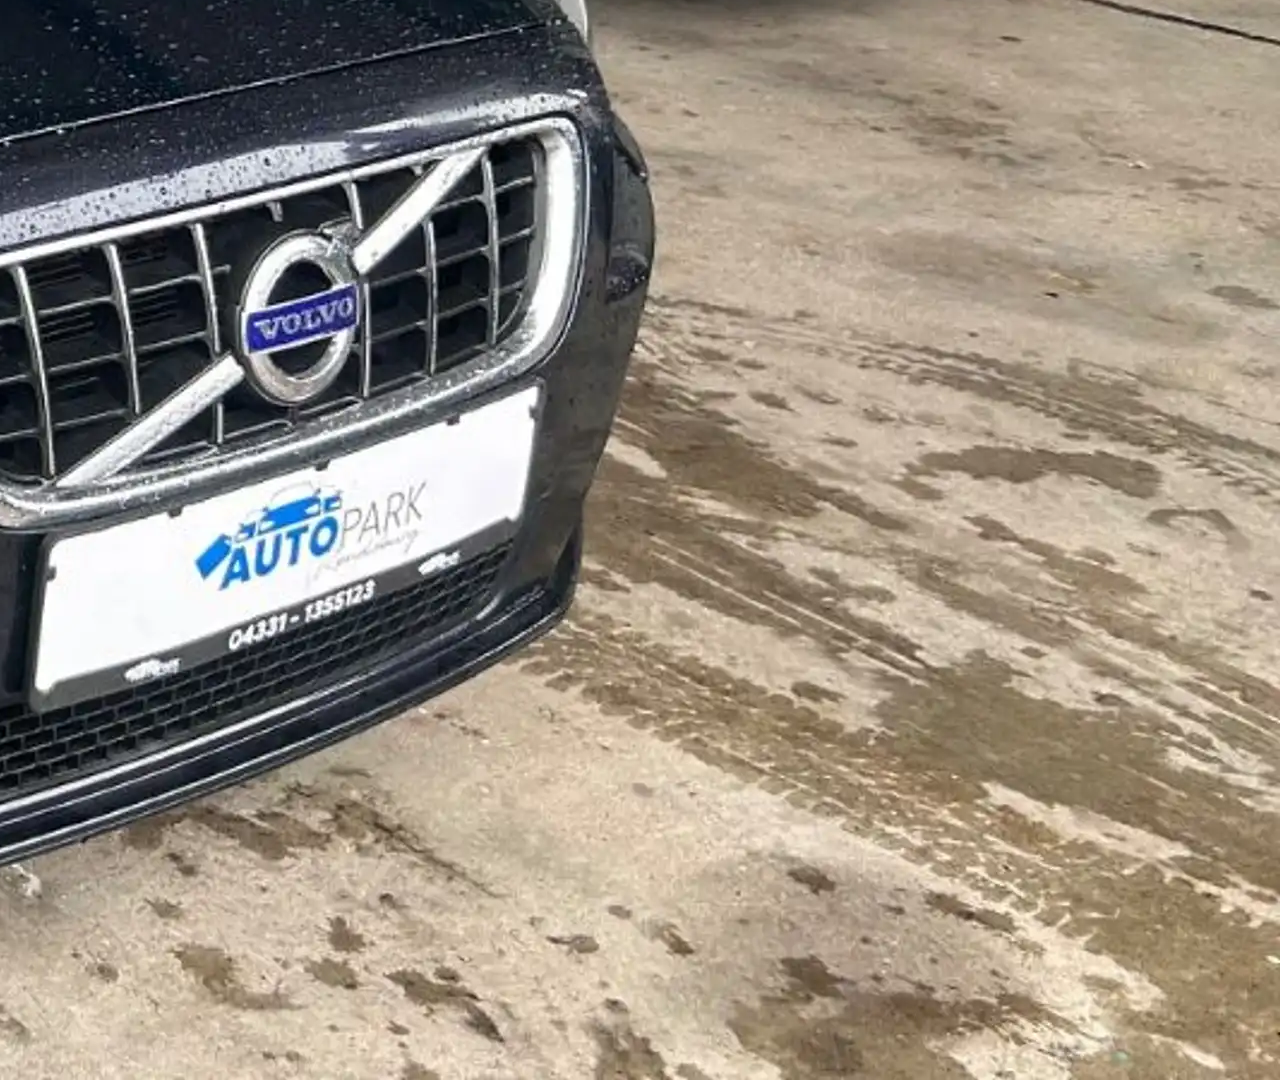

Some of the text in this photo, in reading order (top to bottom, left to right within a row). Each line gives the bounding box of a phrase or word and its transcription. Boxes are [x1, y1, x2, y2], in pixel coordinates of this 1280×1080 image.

[253, 296, 354, 340] VOLVO
[219, 480, 427, 591] AUTOPARK
[228, 612, 288, 651] 04331
[304, 578, 376, 624] 1355123
